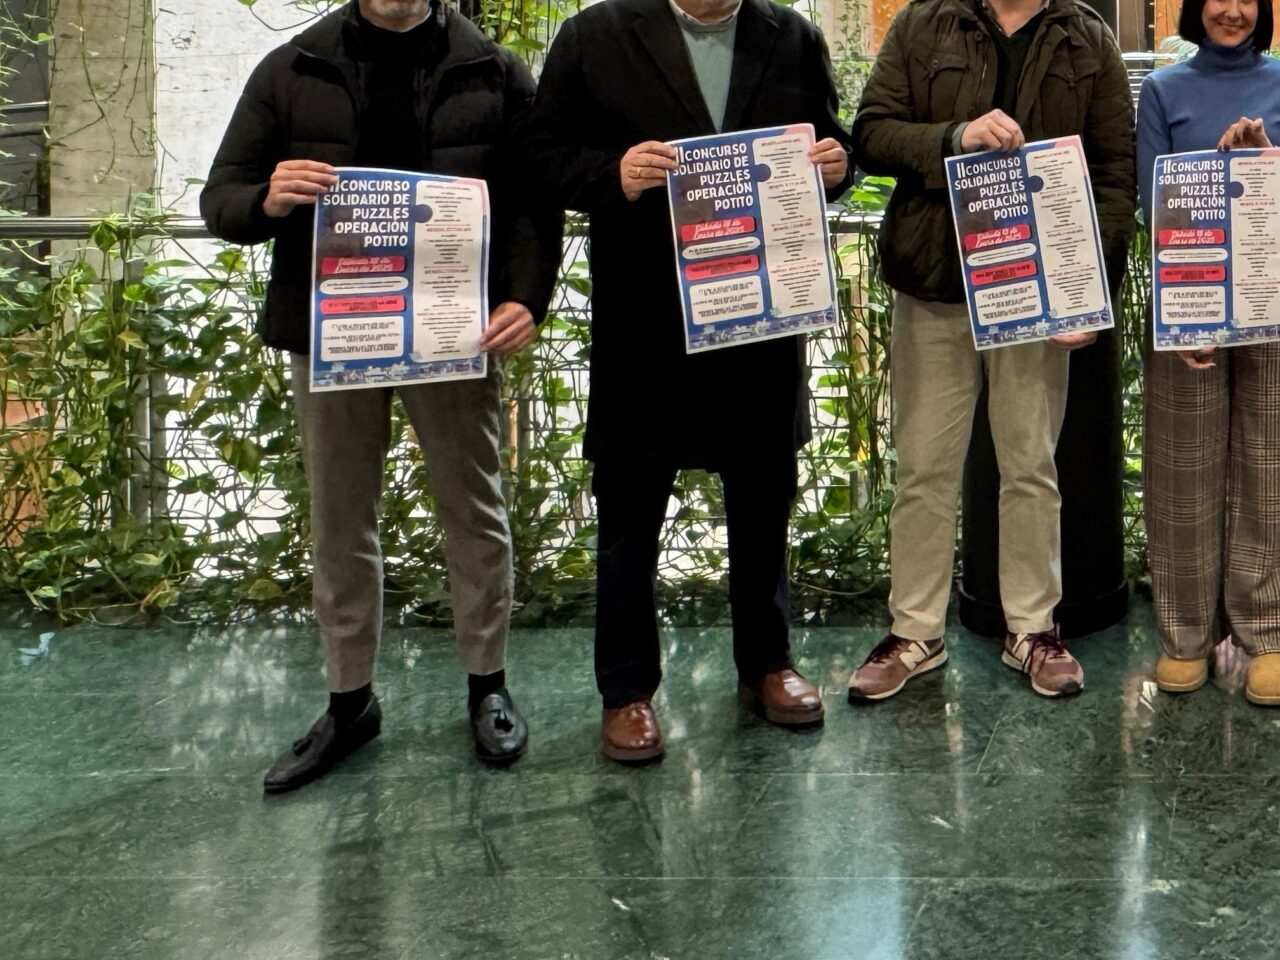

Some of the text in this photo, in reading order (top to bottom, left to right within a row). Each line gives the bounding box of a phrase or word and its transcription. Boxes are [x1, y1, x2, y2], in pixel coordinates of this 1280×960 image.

[684, 142, 747, 162] CONCURSO
[672, 156, 749, 176] SOLIDARIO DE
[966, 157, 1021, 176] CONCURSO
[1171, 159, 1224, 172] CONCURSO
[700, 169, 751, 186] PUZZLES
[954, 168, 1023, 190] SOLIDARIO DE
[1158, 172, 1225, 185] SOLIDARIO DE
[340, 179, 410, 192] CONCURSO
[686, 181, 753, 202] OPERACIÓN
[980, 180, 1025, 198] PUZZLES
[1180, 184, 1225, 196] PUZZLES
[322, 193, 410, 206] SOLIDARIO DE
[714, 195, 753, 211] POTITO
[968, 192, 1028, 213] OPERACIÓN
[1167, 196, 1226, 209] OPERACIÓN
[352, 207, 410, 220] PUZZLES
[994, 205, 1029, 221] POTITO
[1191, 209, 1226, 221] POTITO
[334, 219, 409, 234] OPERACIÓN
[364, 235, 408, 248] POTITO
